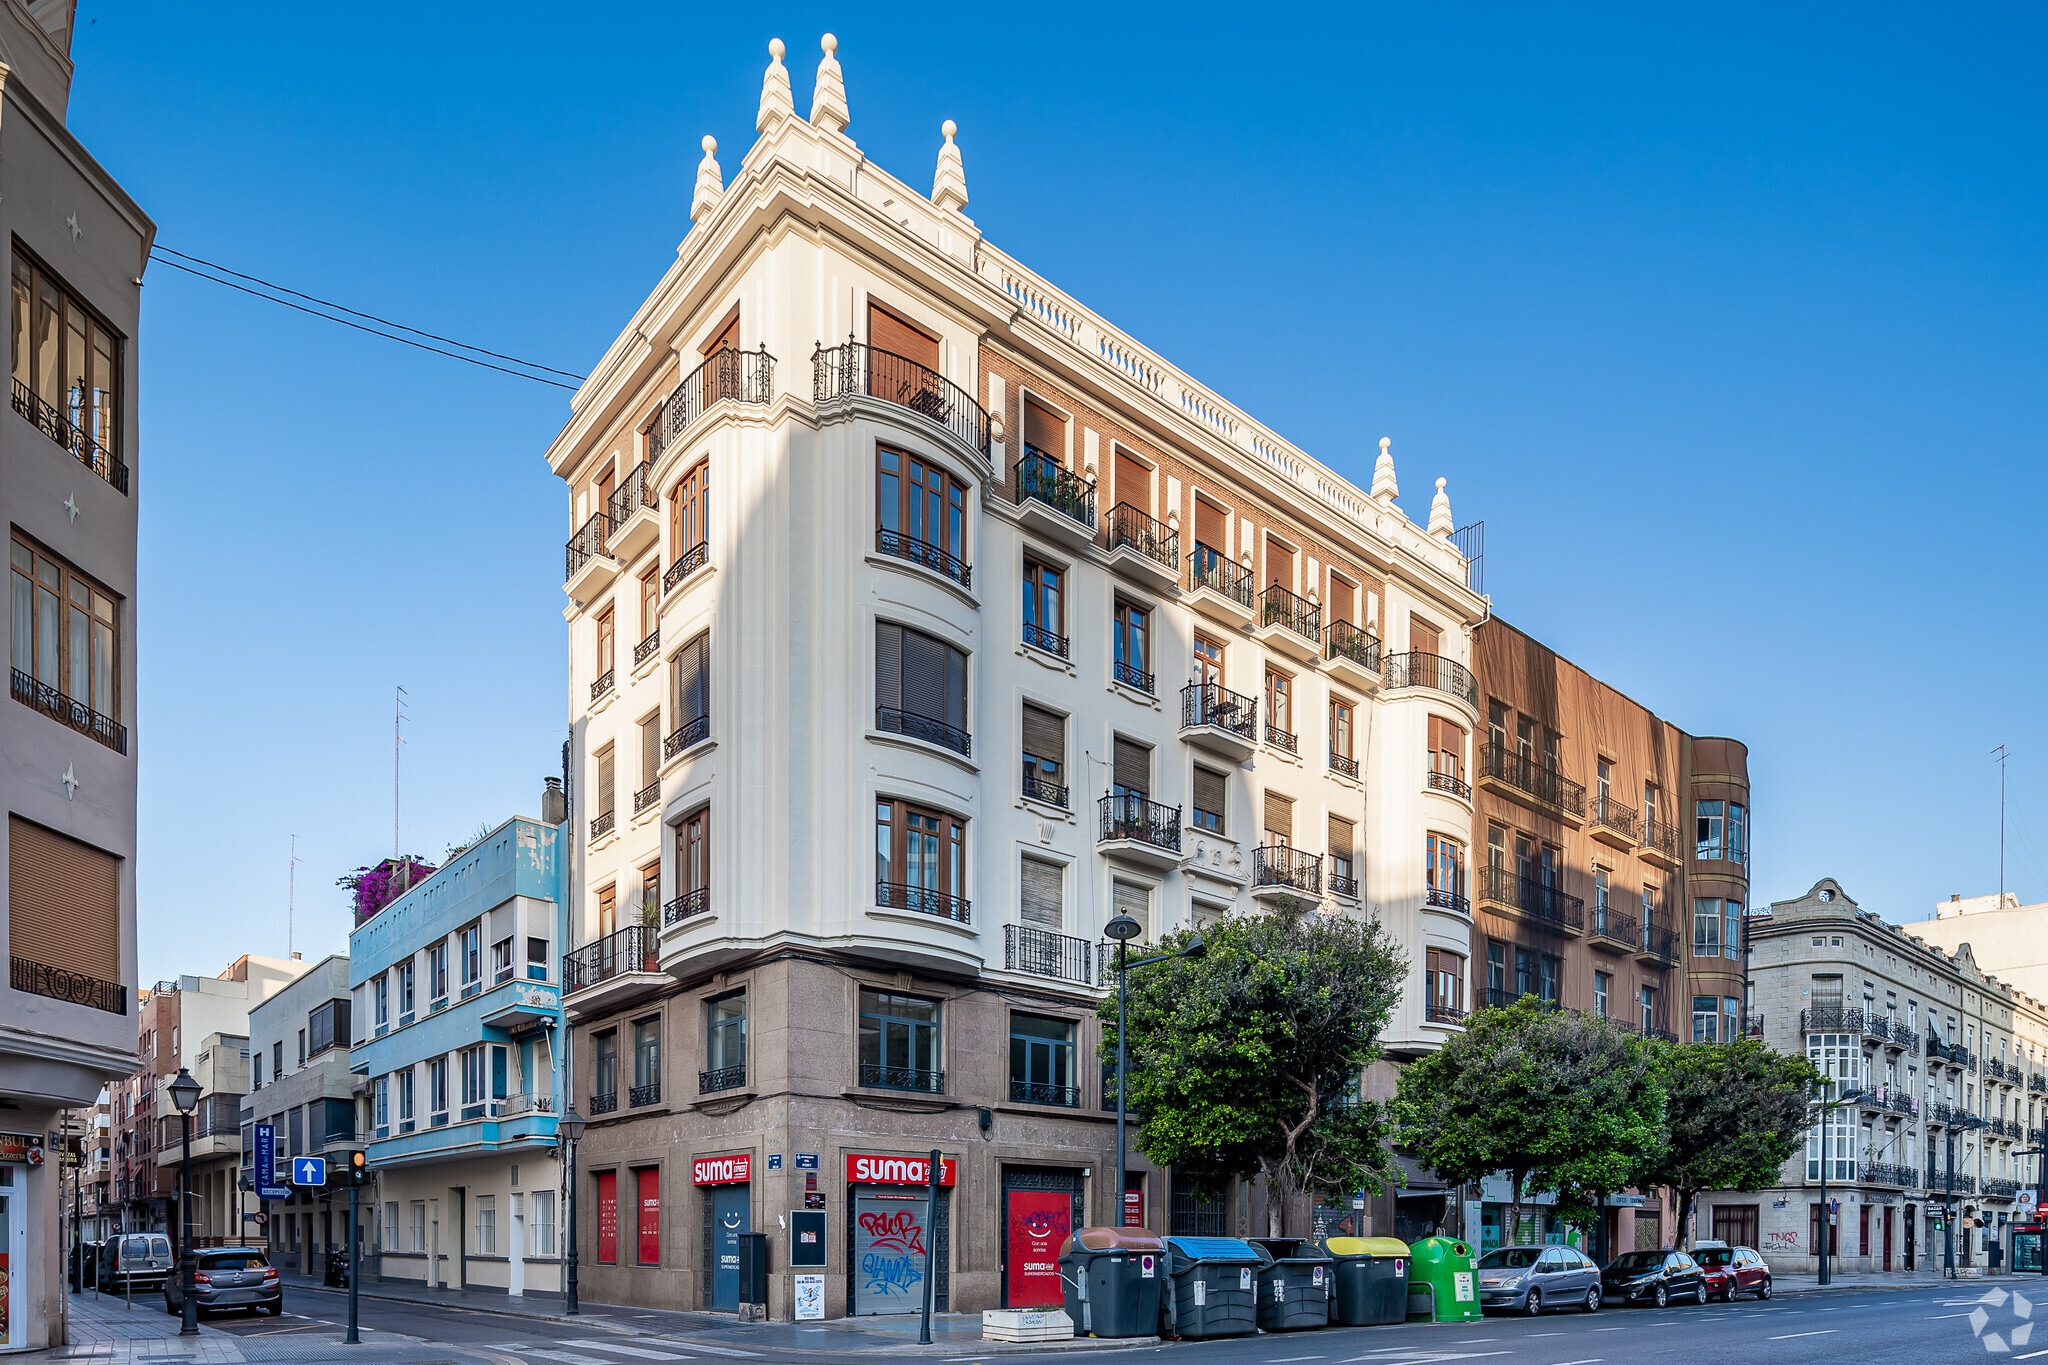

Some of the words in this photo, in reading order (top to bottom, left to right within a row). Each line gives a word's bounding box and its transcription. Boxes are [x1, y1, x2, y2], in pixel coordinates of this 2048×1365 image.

[261, 1137, 270, 1155] MAR
[261, 1163, 270, 1186] CAMA
[695, 1159, 733, 1183] suma
[856, 1158, 923, 1182] suma
[721, 1255, 737, 1263] suma
[1024, 1262, 1045, 1271] suma
